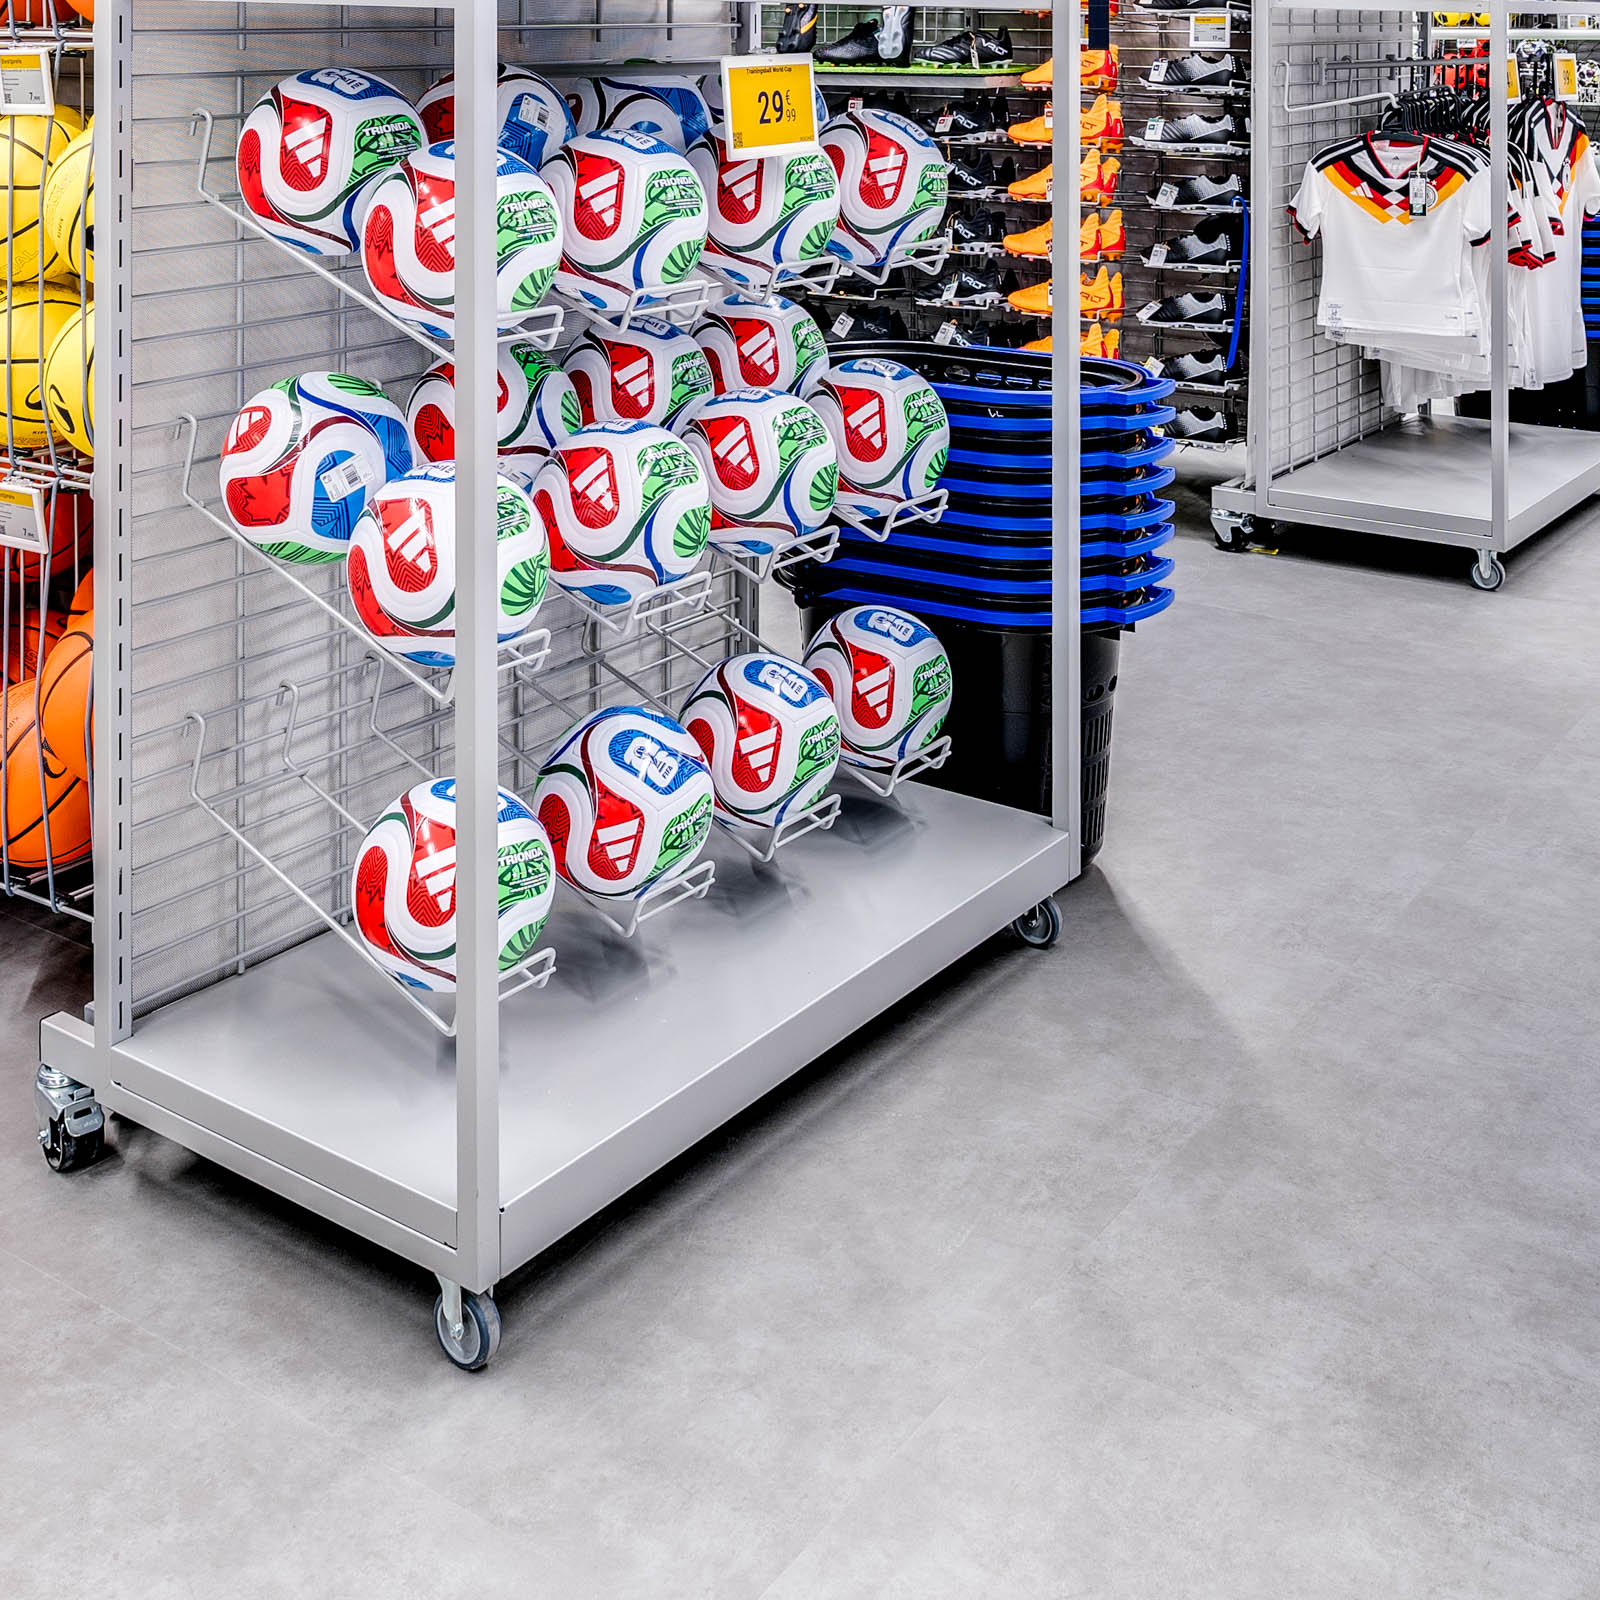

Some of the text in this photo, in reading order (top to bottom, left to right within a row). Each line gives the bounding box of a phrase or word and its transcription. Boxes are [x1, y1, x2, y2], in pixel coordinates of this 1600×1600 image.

[757, 90, 784, 125] 29
[786, 108, 797, 122] 99
[362, 121, 412, 136] TRIONDA
[791, 162, 828, 174] TRIONDA
[651, 176, 695, 188] TRIONDA
[501, 198, 548, 213] TRIONDA
[917, 661, 948, 681] TRIONDA
[804, 723, 839, 746] TRIONDA
[670, 804, 710, 837] TRIONDA
[498, 848, 544, 867] TRIONDA
